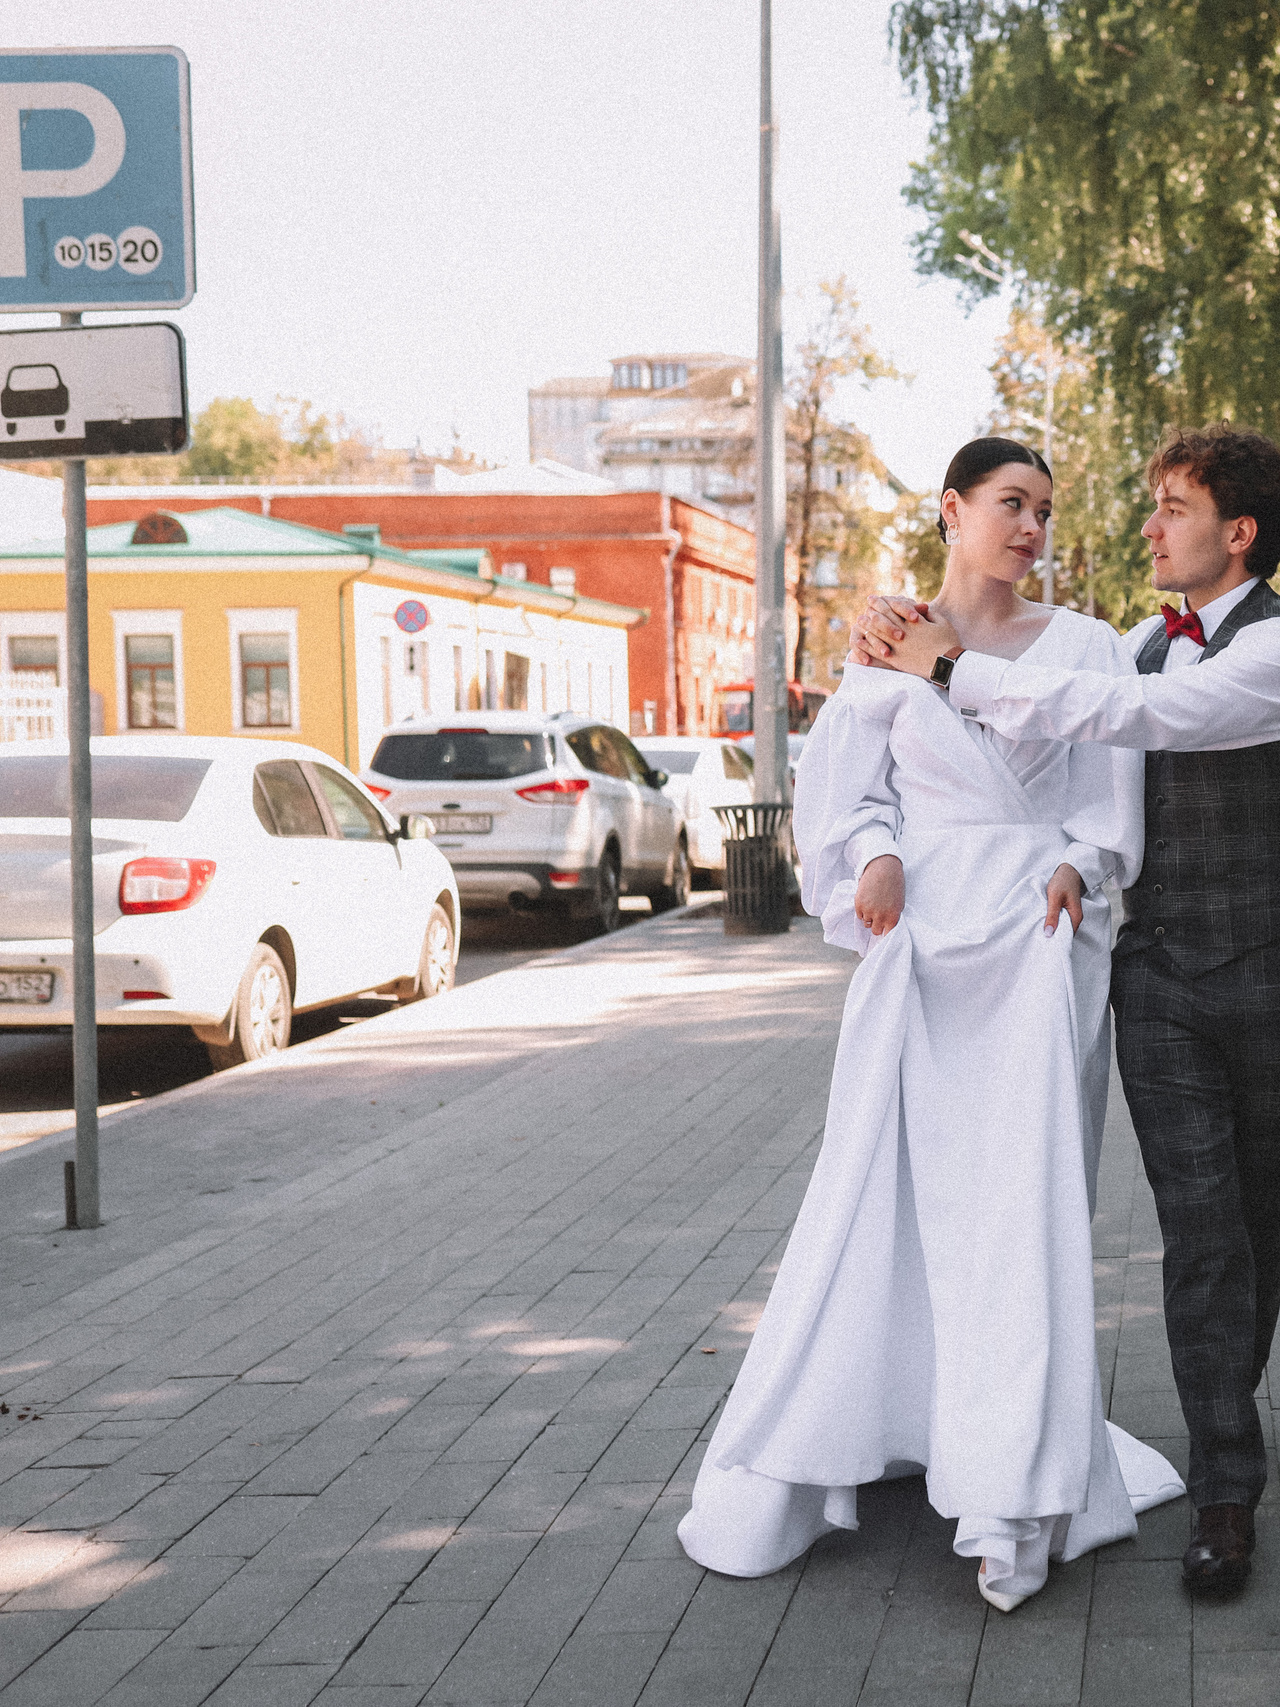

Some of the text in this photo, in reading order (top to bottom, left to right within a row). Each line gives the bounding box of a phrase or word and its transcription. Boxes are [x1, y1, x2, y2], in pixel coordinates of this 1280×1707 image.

[0, 82, 126, 278] P
[59, 239, 159, 263] 10 15 20
